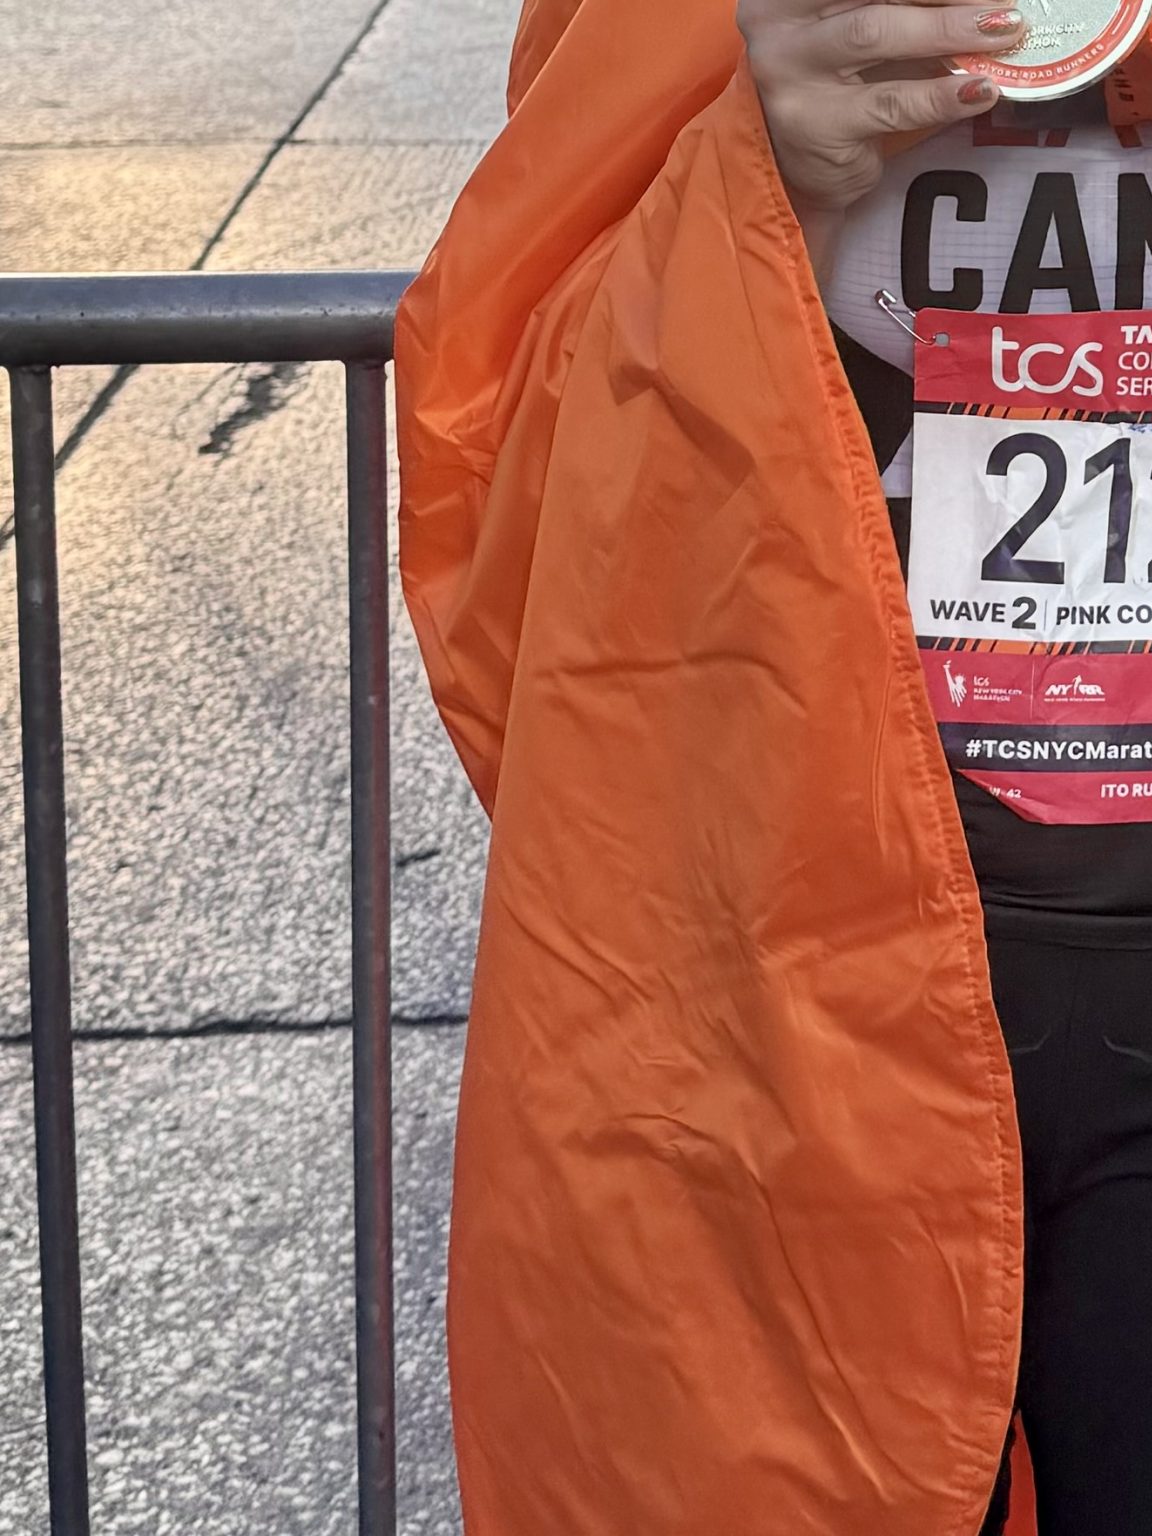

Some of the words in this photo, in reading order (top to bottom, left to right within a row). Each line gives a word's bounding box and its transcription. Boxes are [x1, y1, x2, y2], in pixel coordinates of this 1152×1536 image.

[991, 326, 1104, 397] tcs
[930, 599, 1006, 624] WAVE
[1011, 596, 1037, 630] 2
[1056, 604, 1111, 626] PINK
[1101, 784, 1129, 798] ITO
